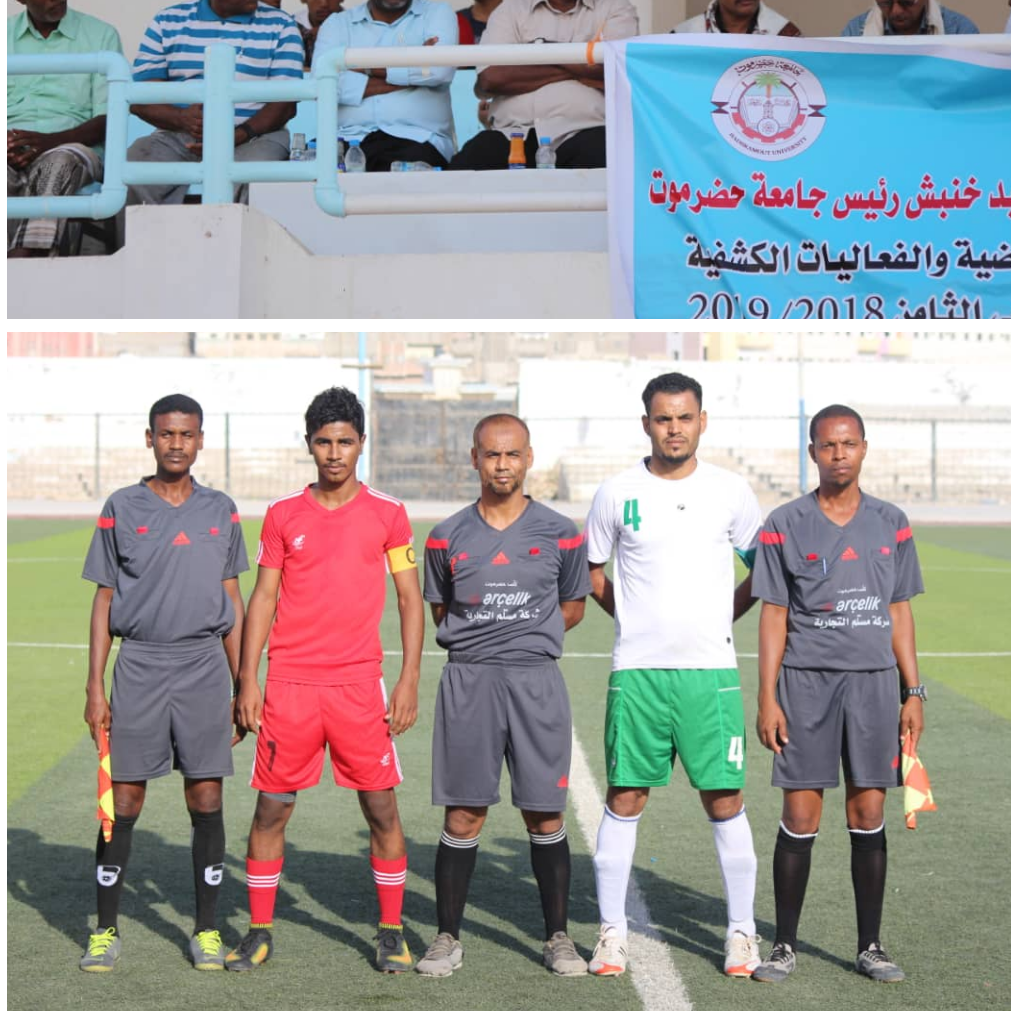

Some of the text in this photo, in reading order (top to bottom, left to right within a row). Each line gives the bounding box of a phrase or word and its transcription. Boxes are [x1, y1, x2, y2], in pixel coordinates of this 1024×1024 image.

[649, 170, 745, 214] حضرموت
[752, 172, 826, 219] جامعة
[833, 177, 900, 220] رئيس
[905, 174, 982, 220] خنبش
[684, 234, 791, 278] الكشفية
[797, 240, 949, 281] والفعاليات
[623, 498, 642, 532] 4
[482, 592, 532, 607] arçelik
[835, 596, 881, 614] arçelik
[813, 616, 849, 629] التجارية
[728, 736, 744, 769] 4
